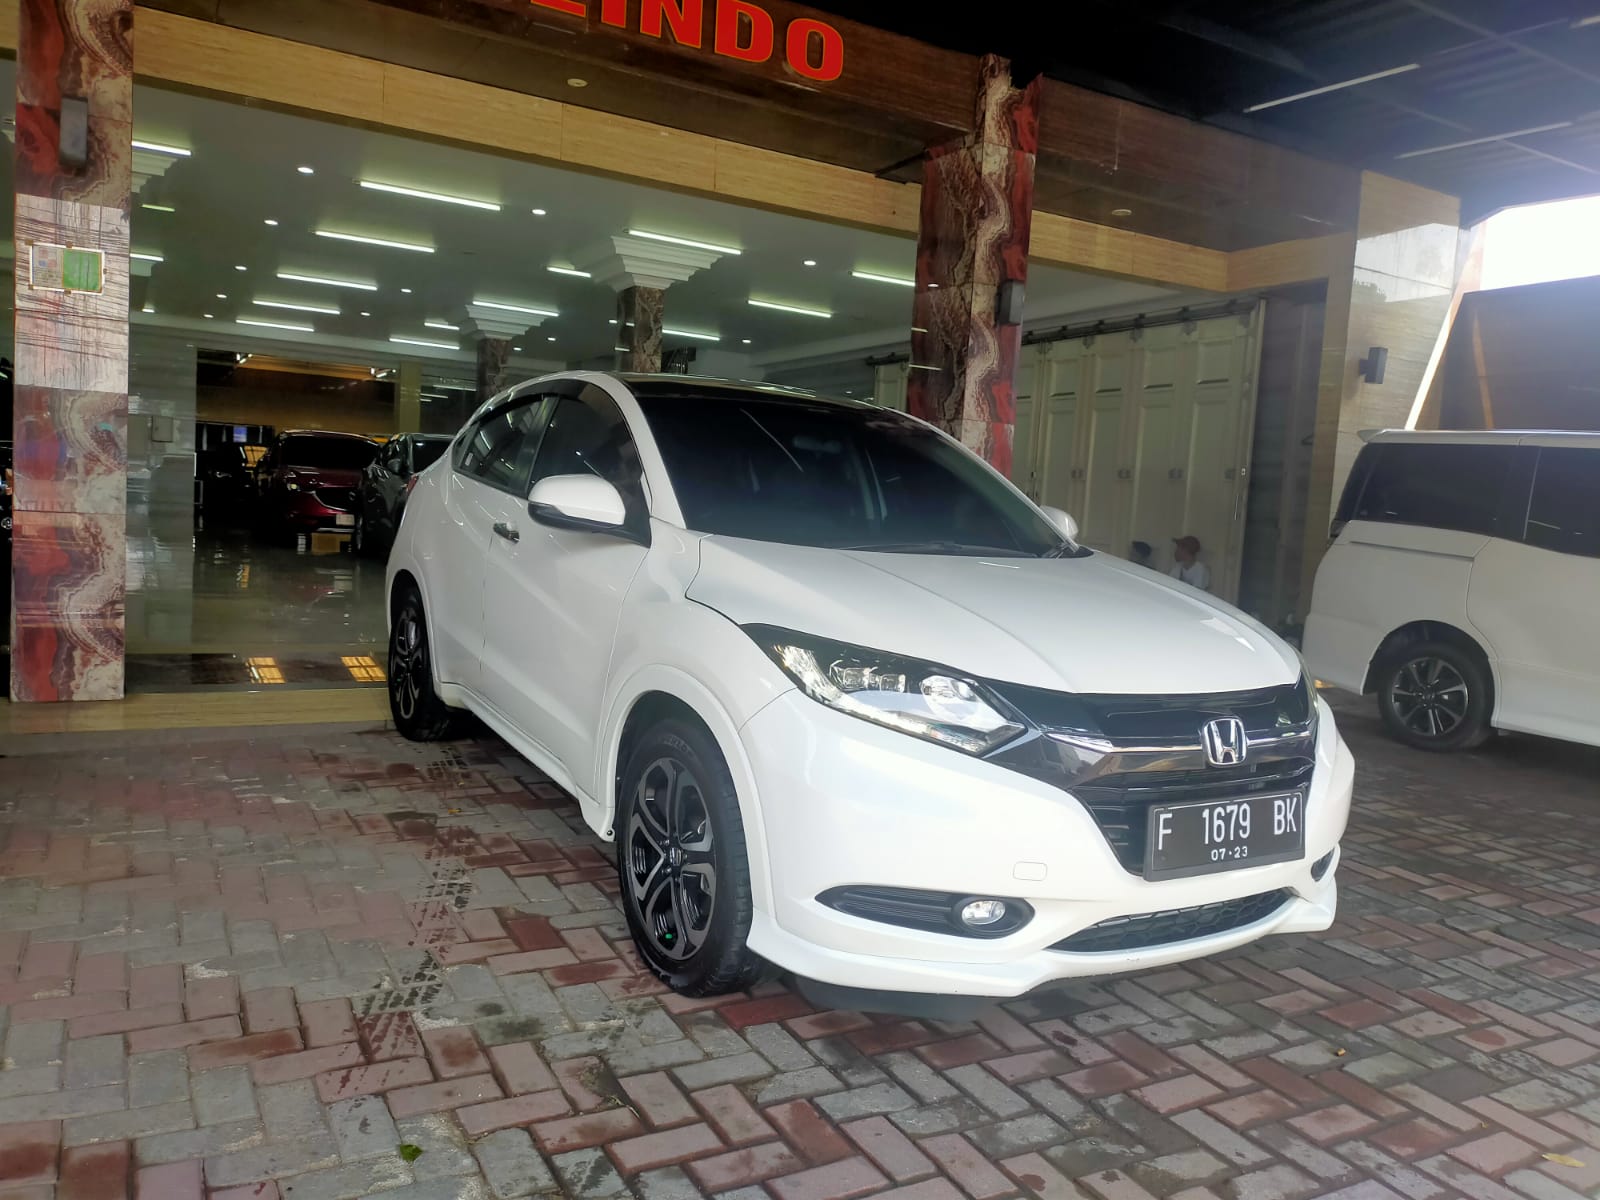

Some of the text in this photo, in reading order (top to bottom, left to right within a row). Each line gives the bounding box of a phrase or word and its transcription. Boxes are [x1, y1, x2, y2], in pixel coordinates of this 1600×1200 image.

[530, 0, 843, 81] NDO
[1158, 797, 1297, 850] F 1679 BK
